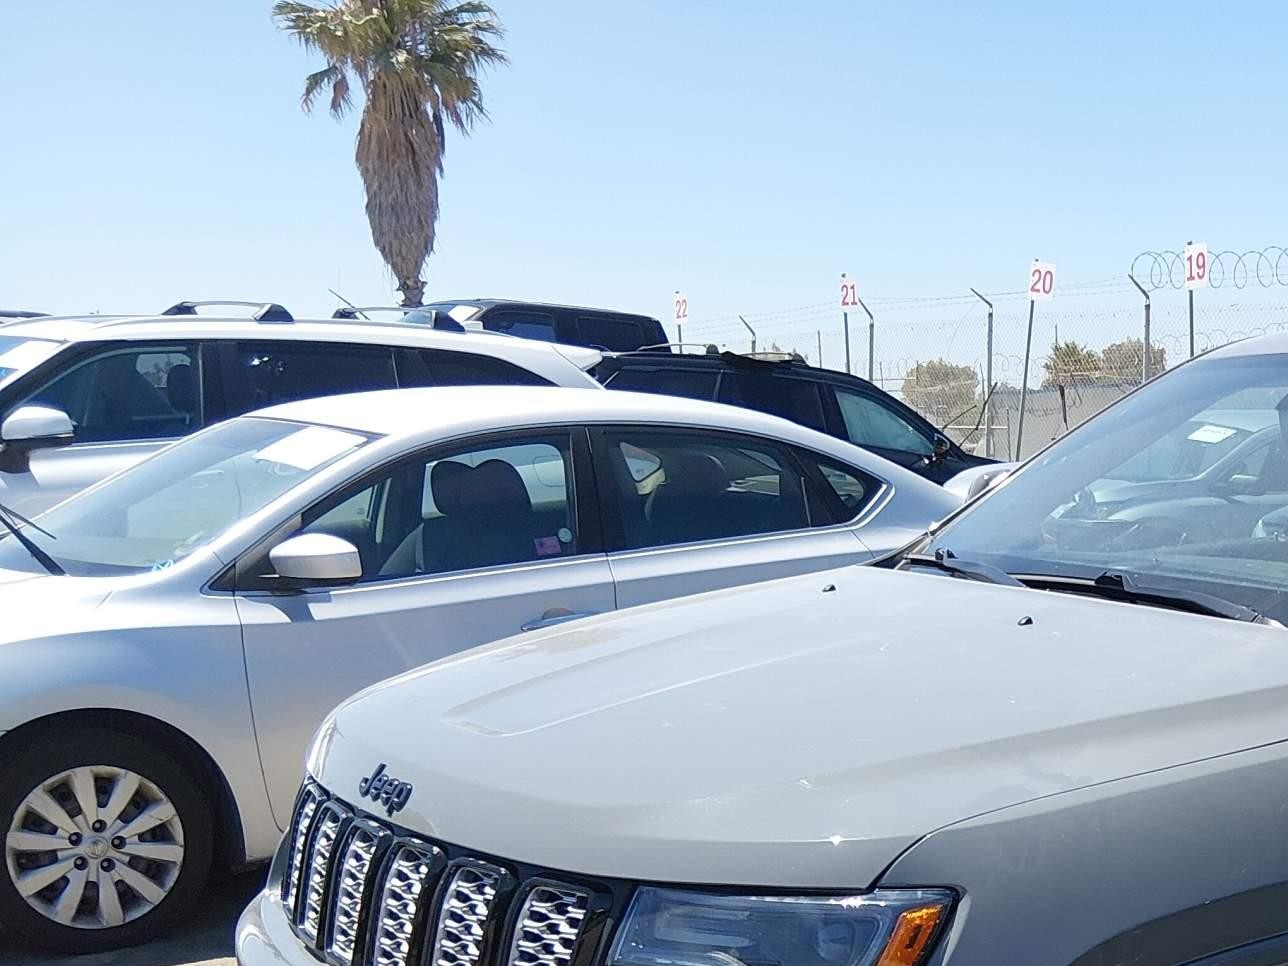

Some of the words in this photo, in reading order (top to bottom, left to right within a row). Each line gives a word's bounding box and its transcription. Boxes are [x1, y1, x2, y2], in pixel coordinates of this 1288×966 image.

[1186, 252, 1206, 281] 19
[1030, 268, 1054, 294] 20
[841, 284, 858, 306] 21
[675, 299, 688, 319] 22
[359, 763, 413, 818] Jeep
